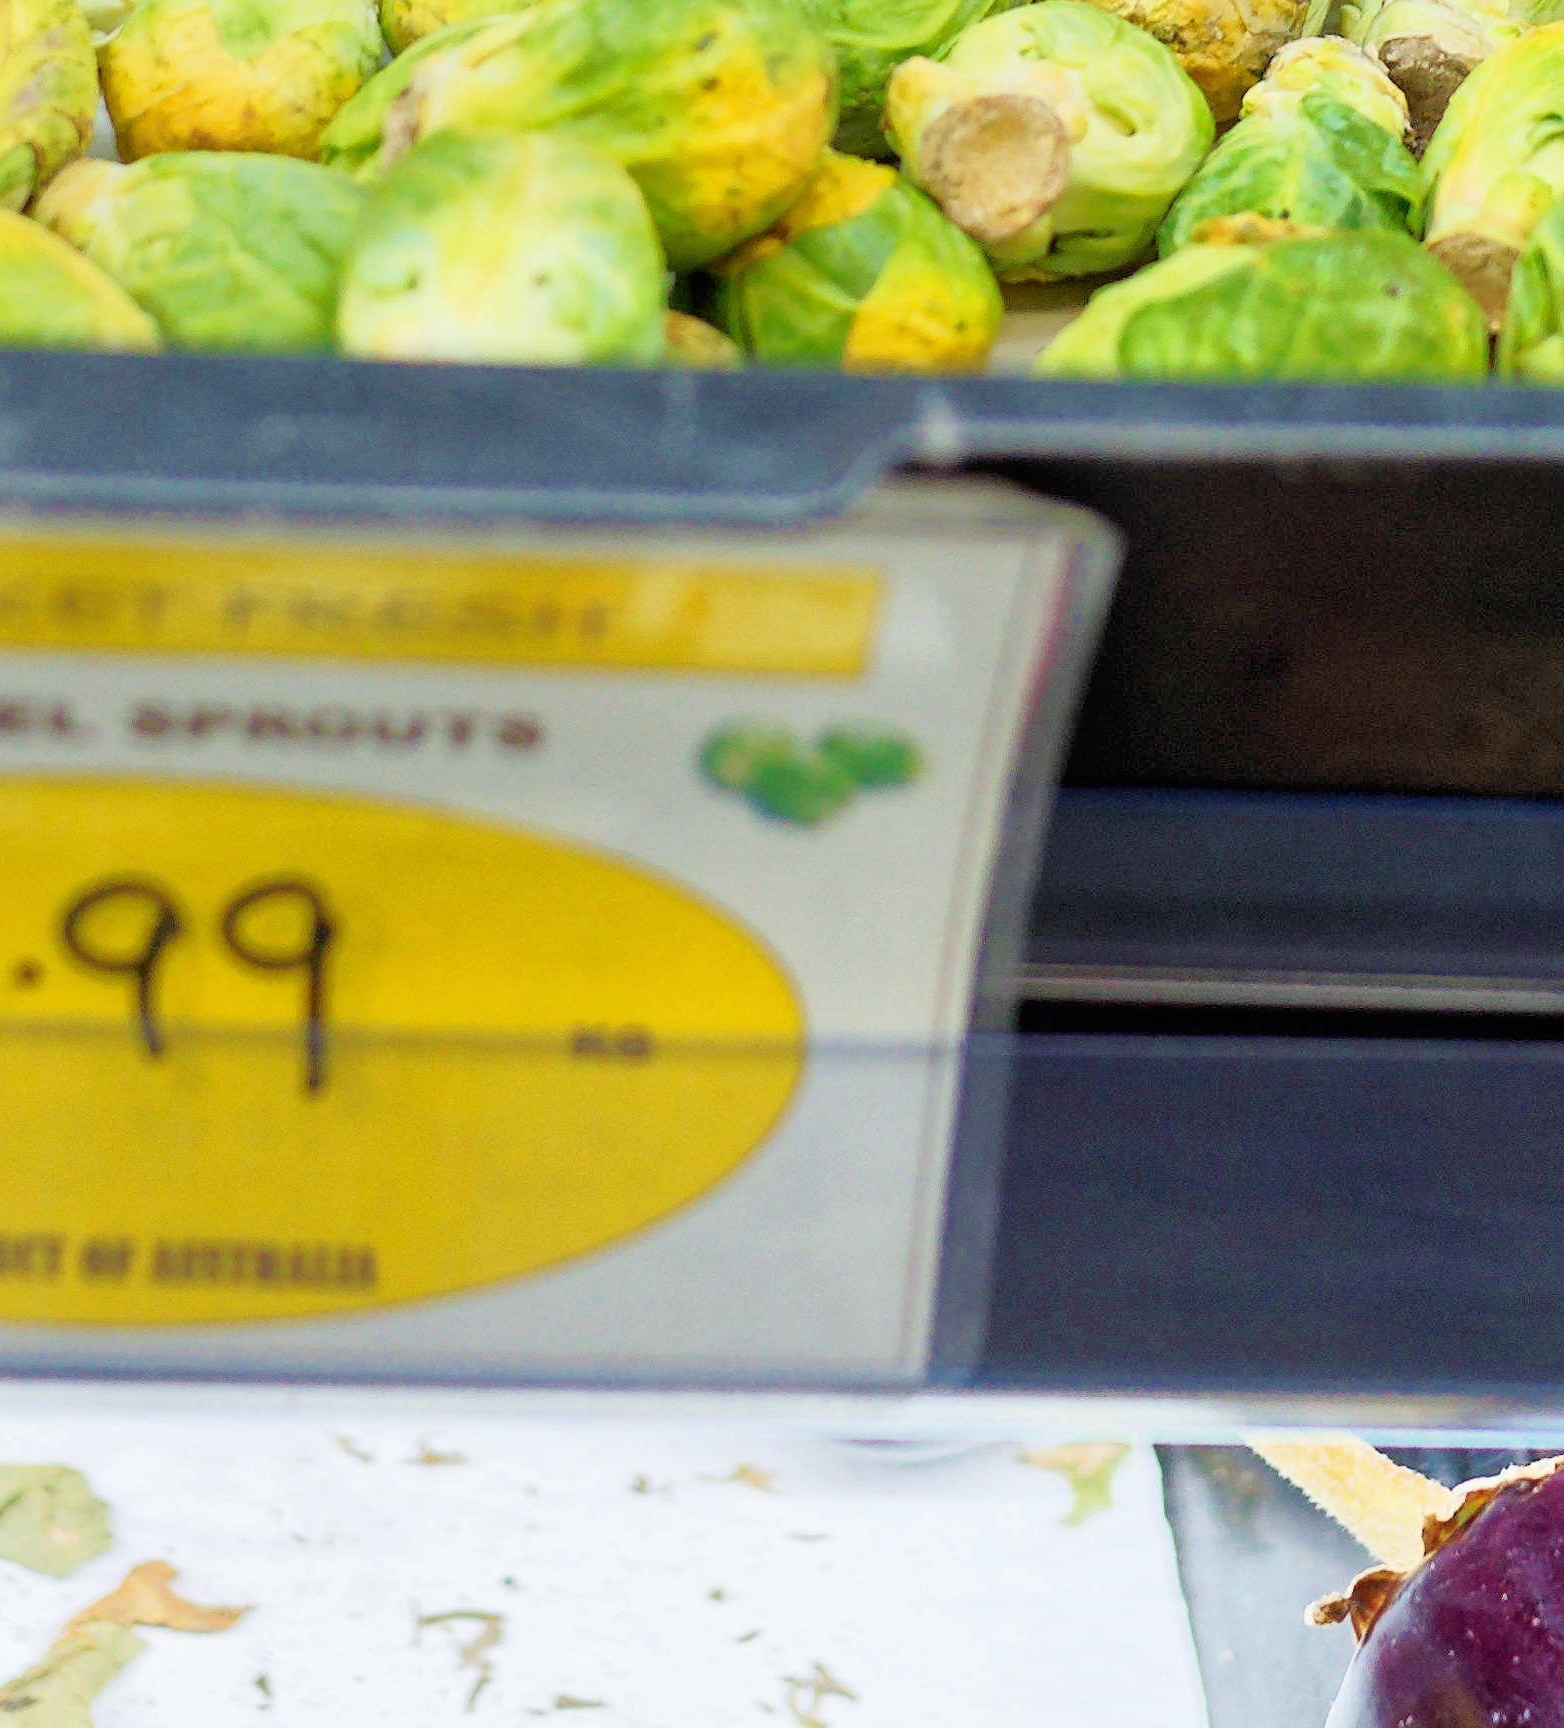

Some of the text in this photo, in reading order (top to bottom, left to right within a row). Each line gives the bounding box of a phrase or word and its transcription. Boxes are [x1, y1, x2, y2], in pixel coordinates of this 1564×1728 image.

[218, 576, 617, 643] FRESH
[127, 697, 545, 753] SPROUTS
[80, 1233, 135, 1284] OF
[149, 1235, 379, 1294] AUSTRALIA
